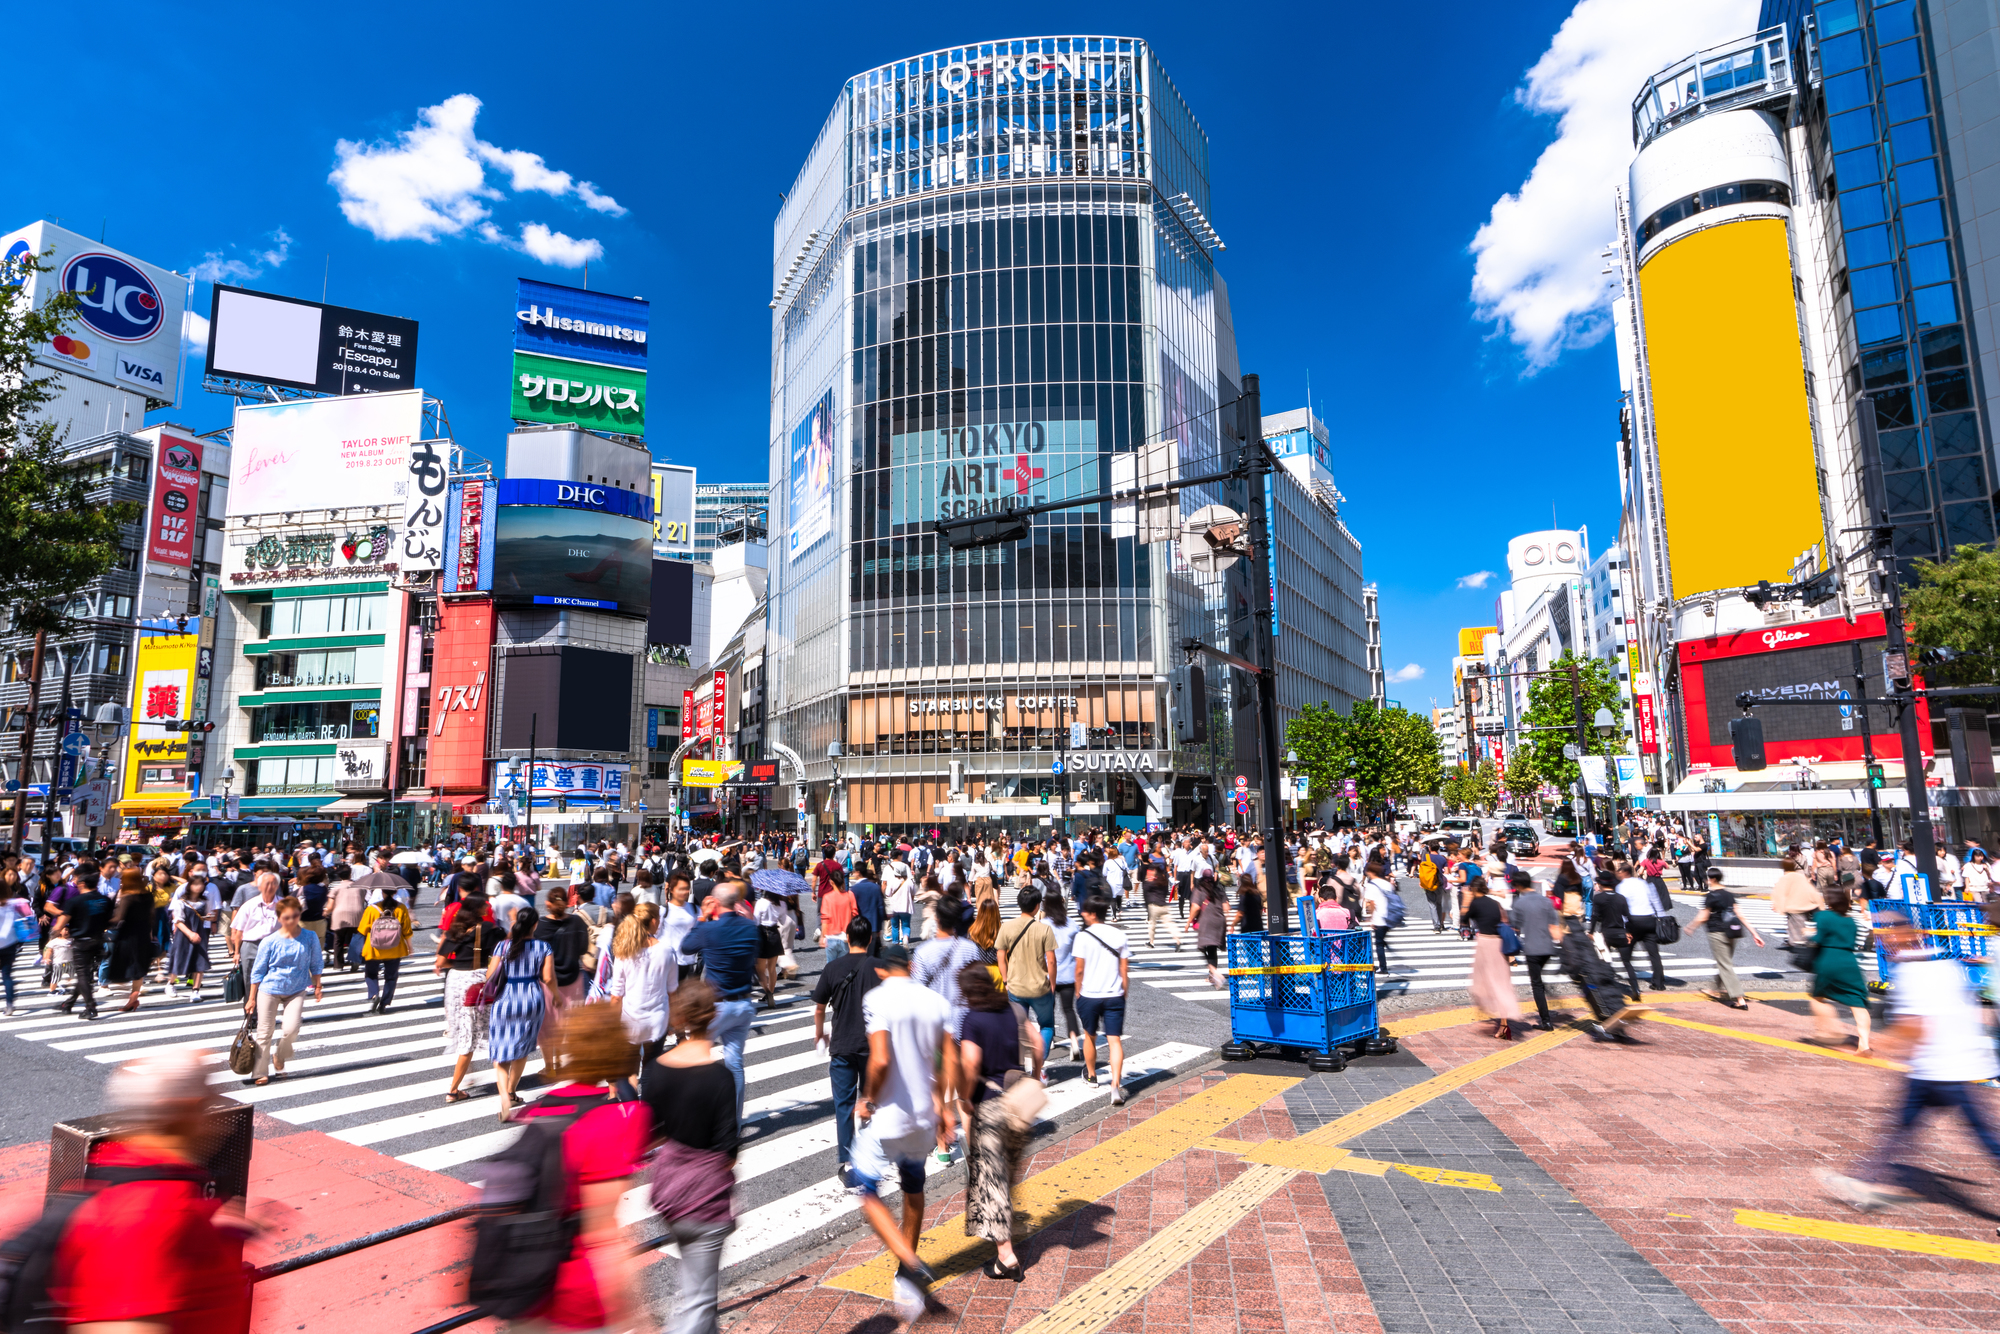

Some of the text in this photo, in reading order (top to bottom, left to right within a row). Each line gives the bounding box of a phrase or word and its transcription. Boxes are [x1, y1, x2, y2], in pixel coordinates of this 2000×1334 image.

[75, 265, 153, 325] UC
[516, 304, 647, 343] Hisamitsu
[338, 325, 402, 347] 鈴木愛理
[353, 342, 387, 353] First Single
[52, 352, 89, 367] mastercard
[120, 360, 163, 385] VISA
[332, 362, 401, 380] 2019.9.4 On Sale
[519, 373, 640, 413] サロンパス
[341, 435, 412, 449] TAYLOR SWIFT
[941, 421, 1044, 459] TOKYO
[340, 451, 357, 459] NEW
[358, 449, 384, 457] ALBUM
[345, 457, 405, 469] 2019.8.23 OUT!
[240, 448, 299, 485] Lover
[941, 463, 1002, 497] ART
[557, 484, 605, 505] DHC
[699, 486, 729, 494] HULIC
[405, 443, 446, 567] もんじゃ
[162, 514, 187, 529] B1F
[160, 528, 186, 543] B2F
[457, 483, 480, 585] 三千里薬品
[568, 549, 590, 558] DHC
[554, 597, 599, 607] DHC Channel
[1761, 630, 1809, 649] Glico
[272, 671, 351, 687] Euphoria
[146, 684, 179, 719] 薬
[434, 671, 486, 736] クスリ
[714, 676, 725, 723] カラオケ
[909, 695, 1077, 713] STARBUCKS COFFEE
[1058, 753, 1154, 770] TSUTAYA
